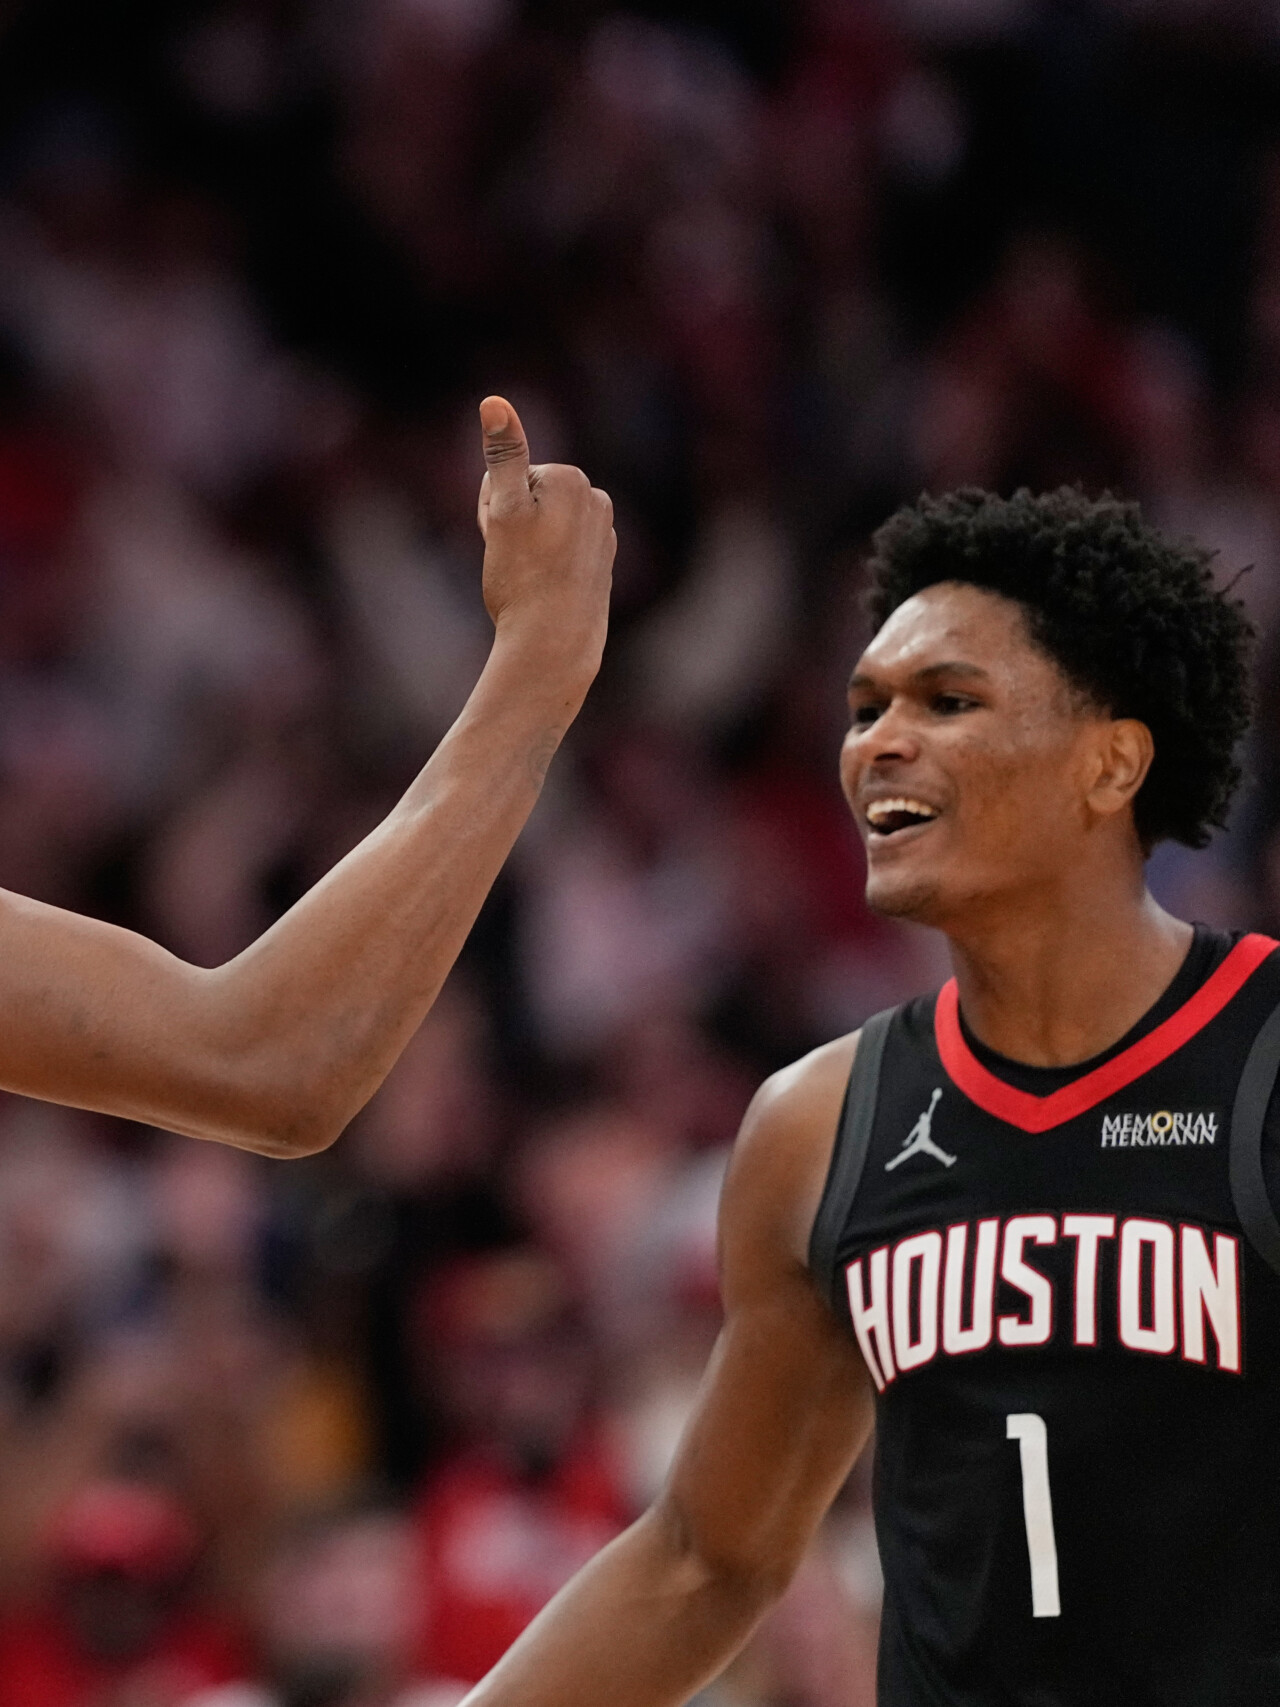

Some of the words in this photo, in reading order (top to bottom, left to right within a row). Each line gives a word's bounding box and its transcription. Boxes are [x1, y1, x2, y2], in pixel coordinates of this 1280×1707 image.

[1101, 1127, 1218, 1148] HERMANN
[1102, 1111, 1218, 1132] MEMORIAL
[845, 1213, 1242, 1394] HOUSTON
[1006, 1413, 1061, 1617] 1
